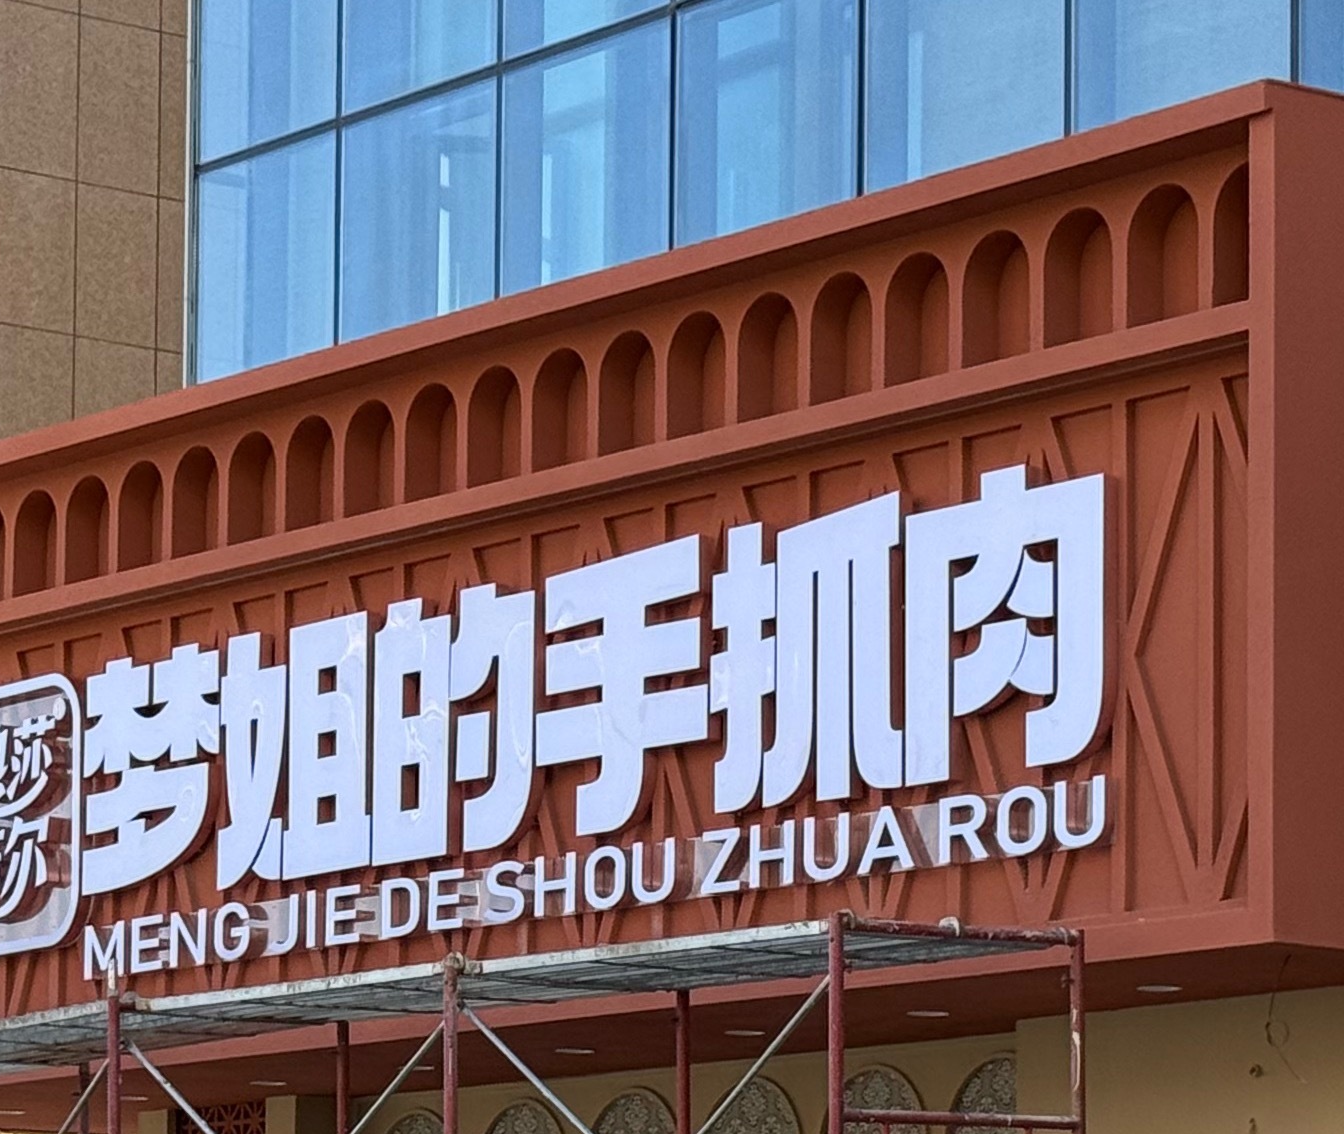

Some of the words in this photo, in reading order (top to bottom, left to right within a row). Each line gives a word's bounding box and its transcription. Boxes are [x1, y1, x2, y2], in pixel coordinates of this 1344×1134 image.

[83, 464, 1106, 895] 梦姐的手抓肉
[83, 902, 250, 981] MENG
[263, 883, 361, 957] JIE
[380, 868, 464, 940] DE
[485, 837, 676, 924] SHOU
[700, 805, 916, 895] ZHUA
[938, 774, 1106, 866] ROU
